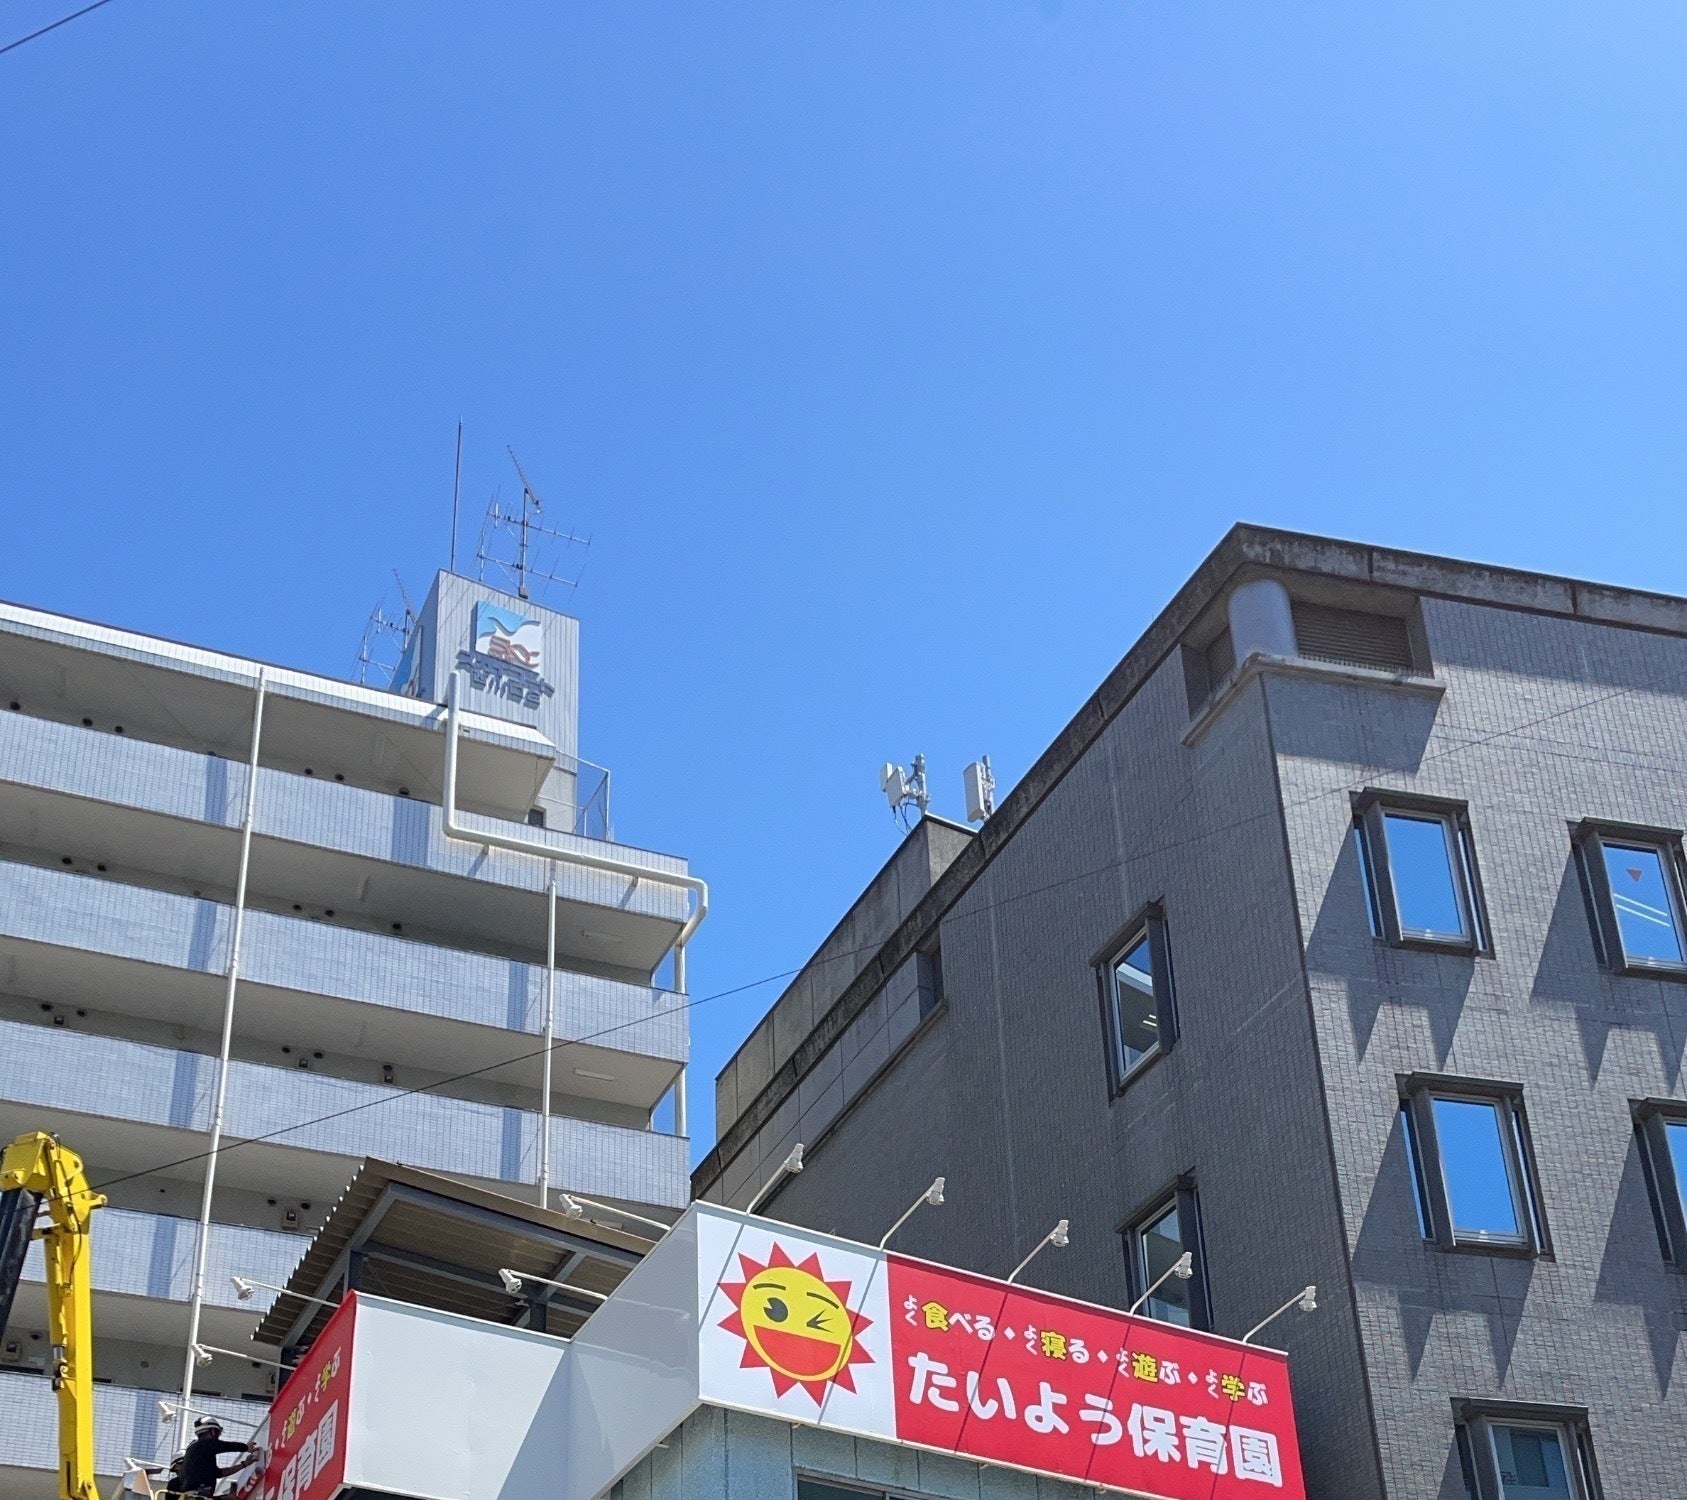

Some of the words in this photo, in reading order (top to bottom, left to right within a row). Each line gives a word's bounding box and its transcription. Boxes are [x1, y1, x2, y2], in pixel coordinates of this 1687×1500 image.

[907, 1352, 1283, 1487] たいよう保育園
